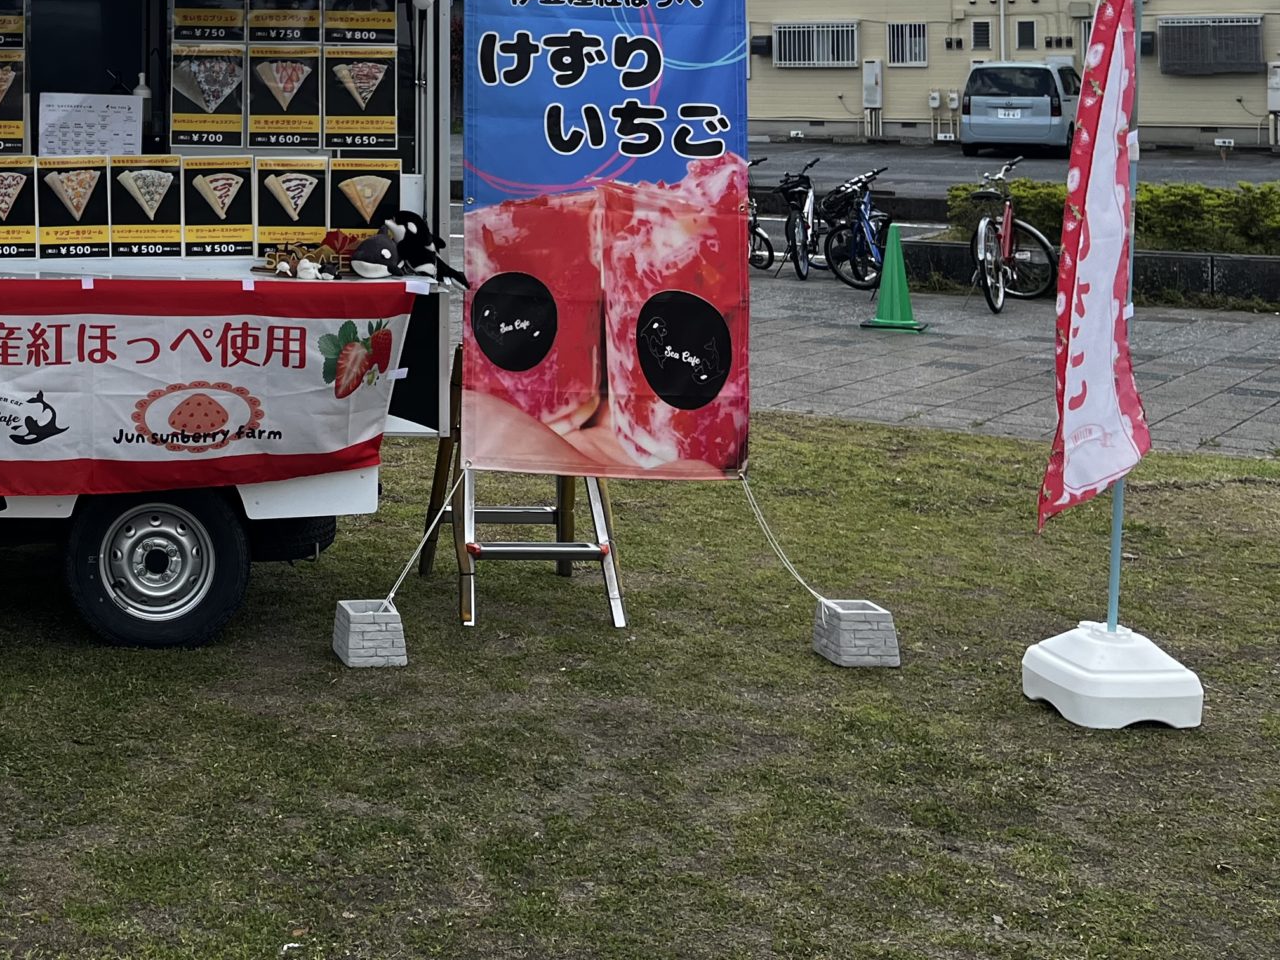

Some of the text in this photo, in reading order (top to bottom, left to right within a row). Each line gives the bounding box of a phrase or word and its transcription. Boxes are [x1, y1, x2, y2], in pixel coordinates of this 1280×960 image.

[195, 28, 225, 38] ¥750
[270, 30, 301, 39] ¥750
[345, 31, 377, 40] ¥800
[478, 28, 665, 90] けずり
[544, 98, 731, 159] いちご
[192, 133, 223, 143] ¥700
[270, 135, 301, 144] ¥600
[345, 136, 377, 145] ¥650
[59, 246, 91, 256] ¥500
[131, 244, 163, 254] ¥500
[204, 244, 236, 253] ¥500
[664, 346, 701, 366] Sea Cafe
[113, 424, 282, 445] Jun sunberry farm
